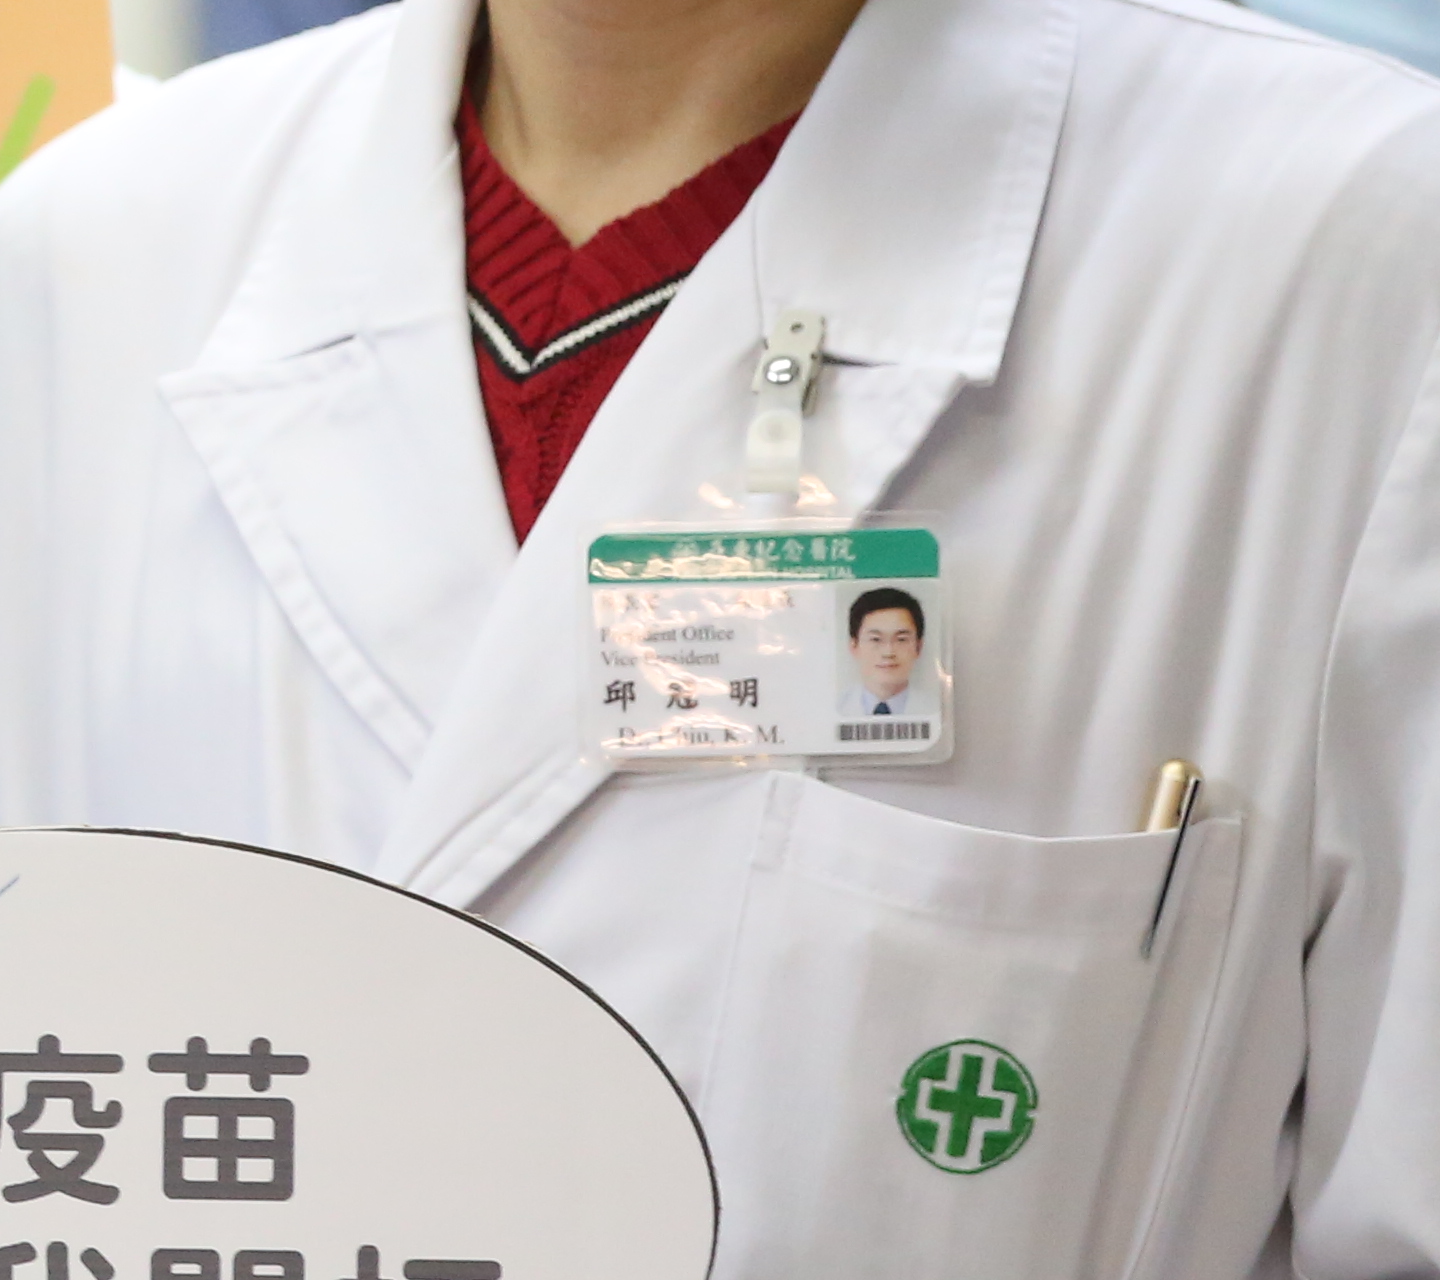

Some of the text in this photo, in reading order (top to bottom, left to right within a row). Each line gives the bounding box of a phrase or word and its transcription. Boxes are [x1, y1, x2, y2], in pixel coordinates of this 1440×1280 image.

[682, 625, 735, 641] Office
[601, 650, 638, 666] Vice
[757, 724, 786, 744] M.
